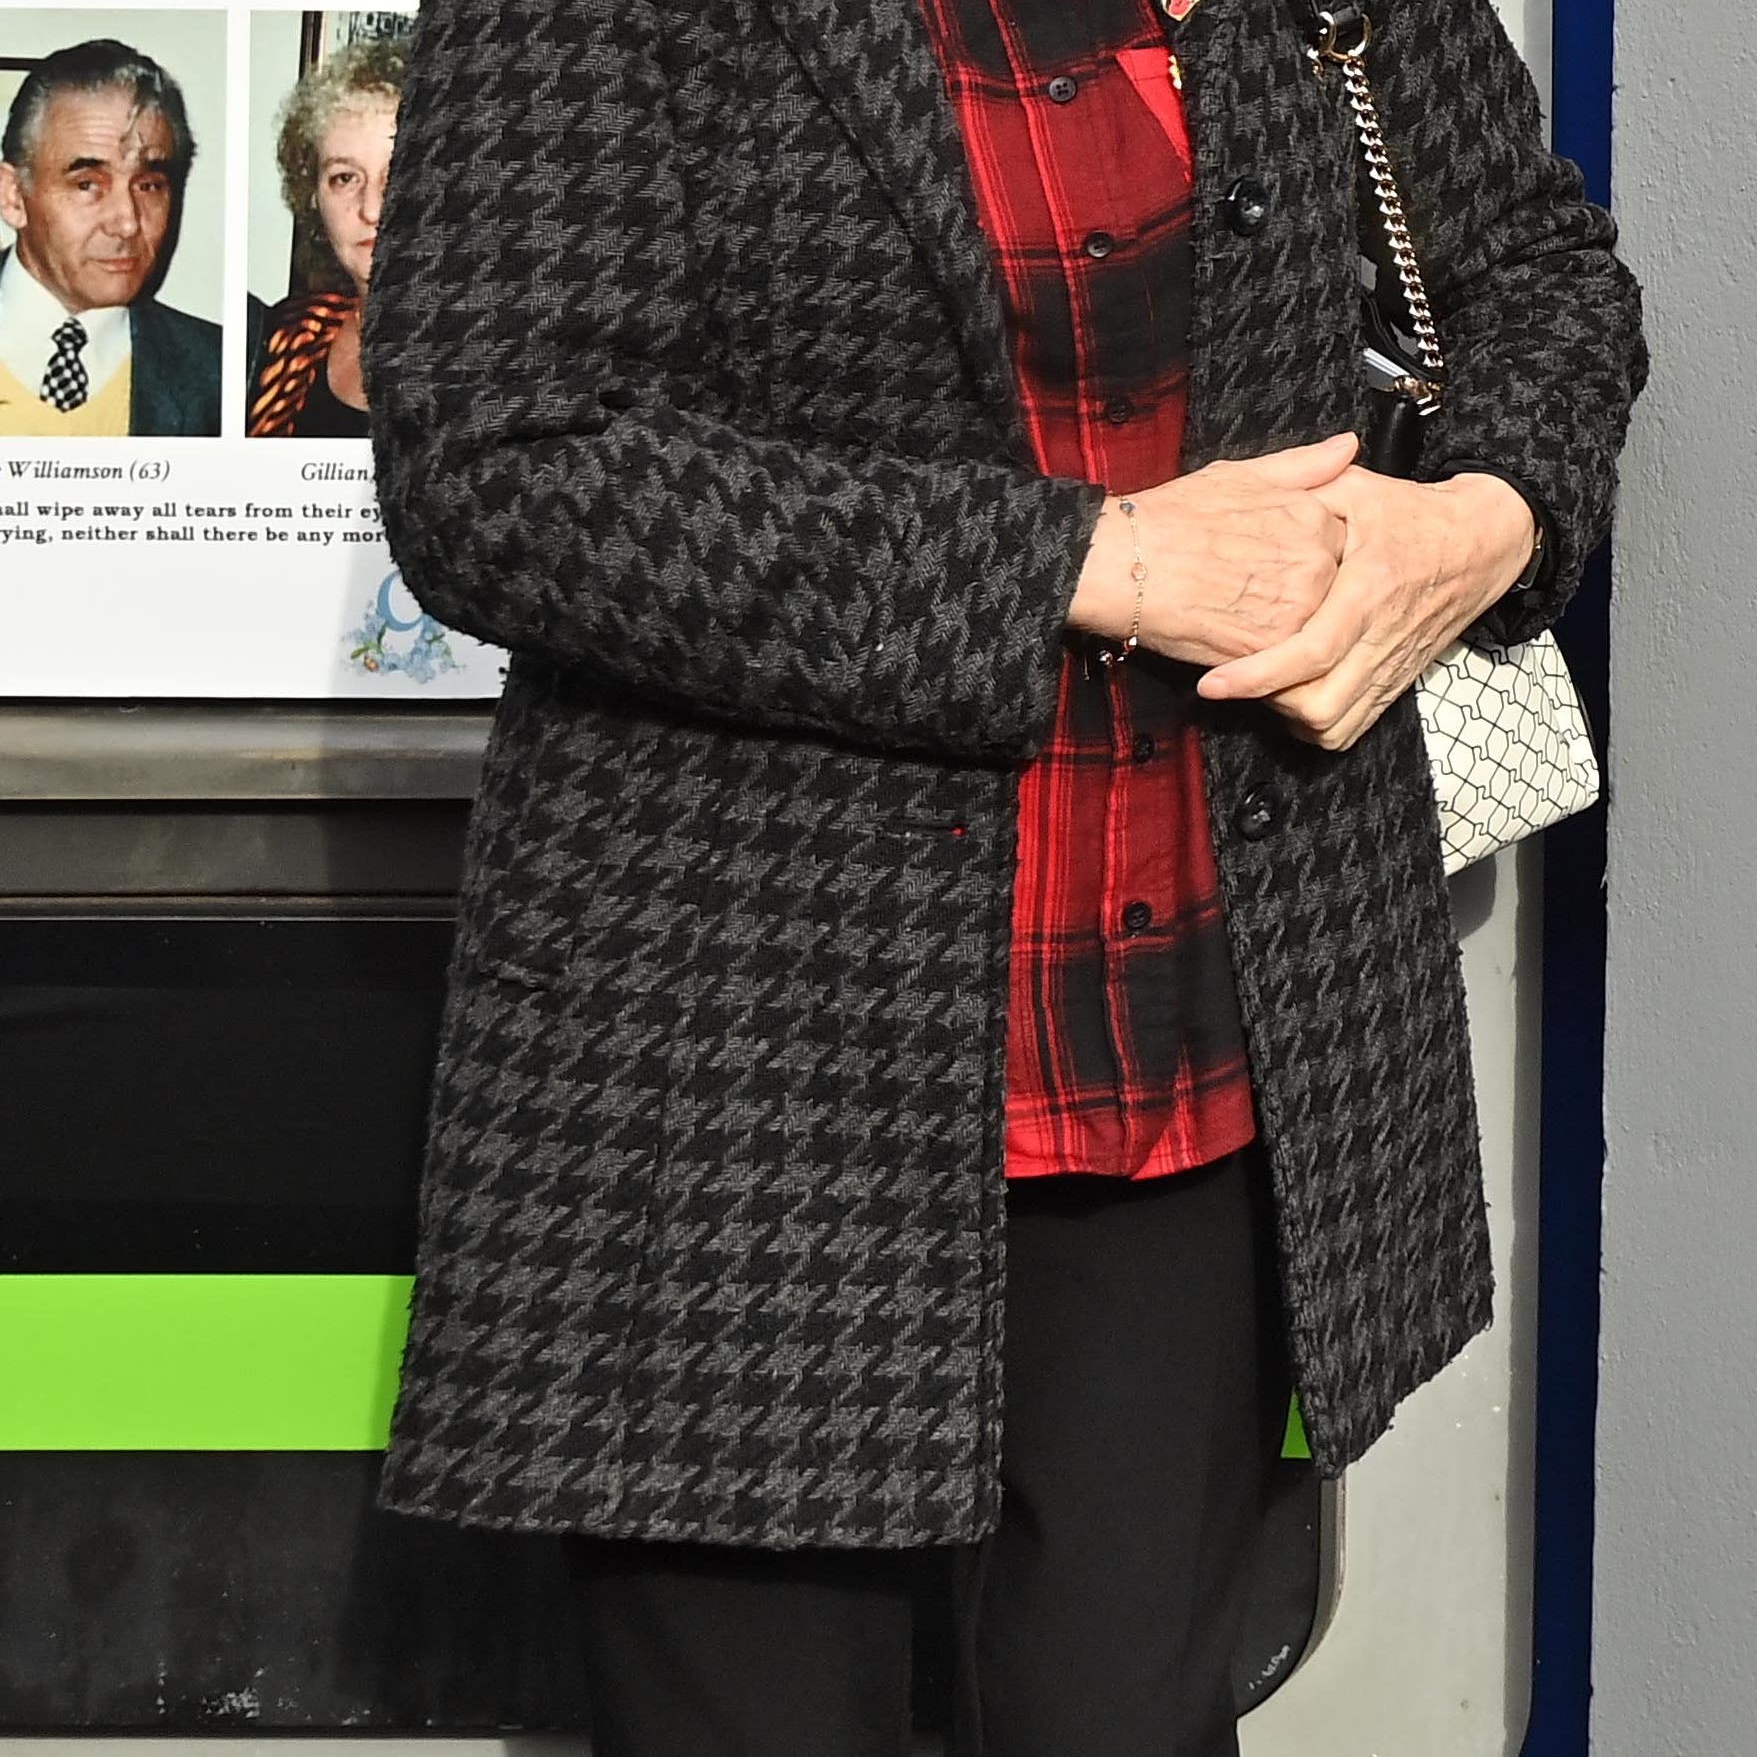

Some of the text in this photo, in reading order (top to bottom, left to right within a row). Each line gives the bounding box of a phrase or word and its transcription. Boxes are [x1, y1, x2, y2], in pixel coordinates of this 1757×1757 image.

[8, 460, 171, 483] Williamson (63)
[301, 461, 368, 482] Gillian
[0, 501, 29, 517] all
[37, 501, 84, 521] wipe
[93, 506, 145, 522] away
[152, 502, 177, 518] all
[185, 503, 237, 518] tears
[245, 502, 293, 518] from
[302, 503, 353, 519] their
[0, 524, 54, 545] ying,
[61, 525, 138, 541] neither
[145, 525, 195, 541] shall
[203, 526, 258, 542] there
[265, 526, 289, 542] be
[297, 531, 335, 546] any
